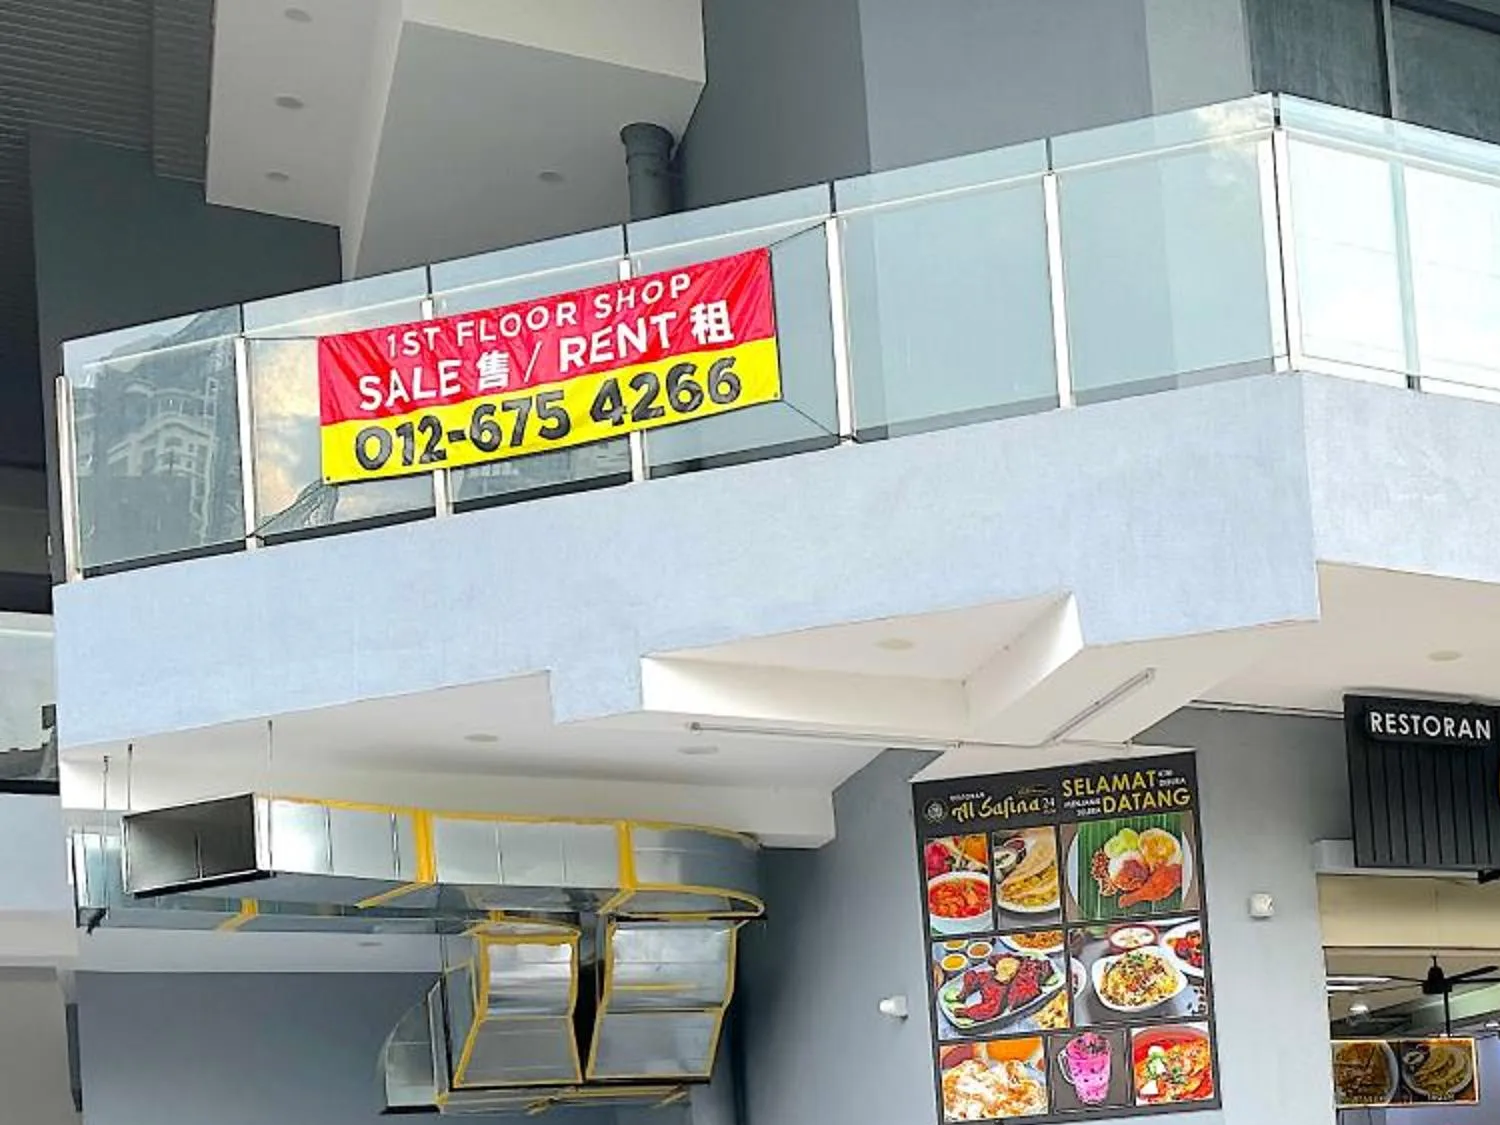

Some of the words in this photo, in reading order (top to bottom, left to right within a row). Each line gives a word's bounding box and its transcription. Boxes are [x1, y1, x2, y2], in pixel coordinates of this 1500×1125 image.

[386, 325, 440, 361] 1ST
[456, 302, 578, 345] FLOOR
[593, 272, 692, 320] SHOP
[358, 358, 463, 412] SALE
[476, 352, 511, 391] 售
[558, 311, 679, 373] RENT
[688, 299, 735, 345] 租
[354, 389, 572, 472] 012-675
[589, 356, 742, 428] 4266
[1369, 711, 1491, 739] RESTORAN
[1062, 769, 1156, 797] SELAMAT
[951, 801, 976, 823] Al
[978, 795, 1042, 819] Safina
[1103, 787, 1191, 814] DATANG
